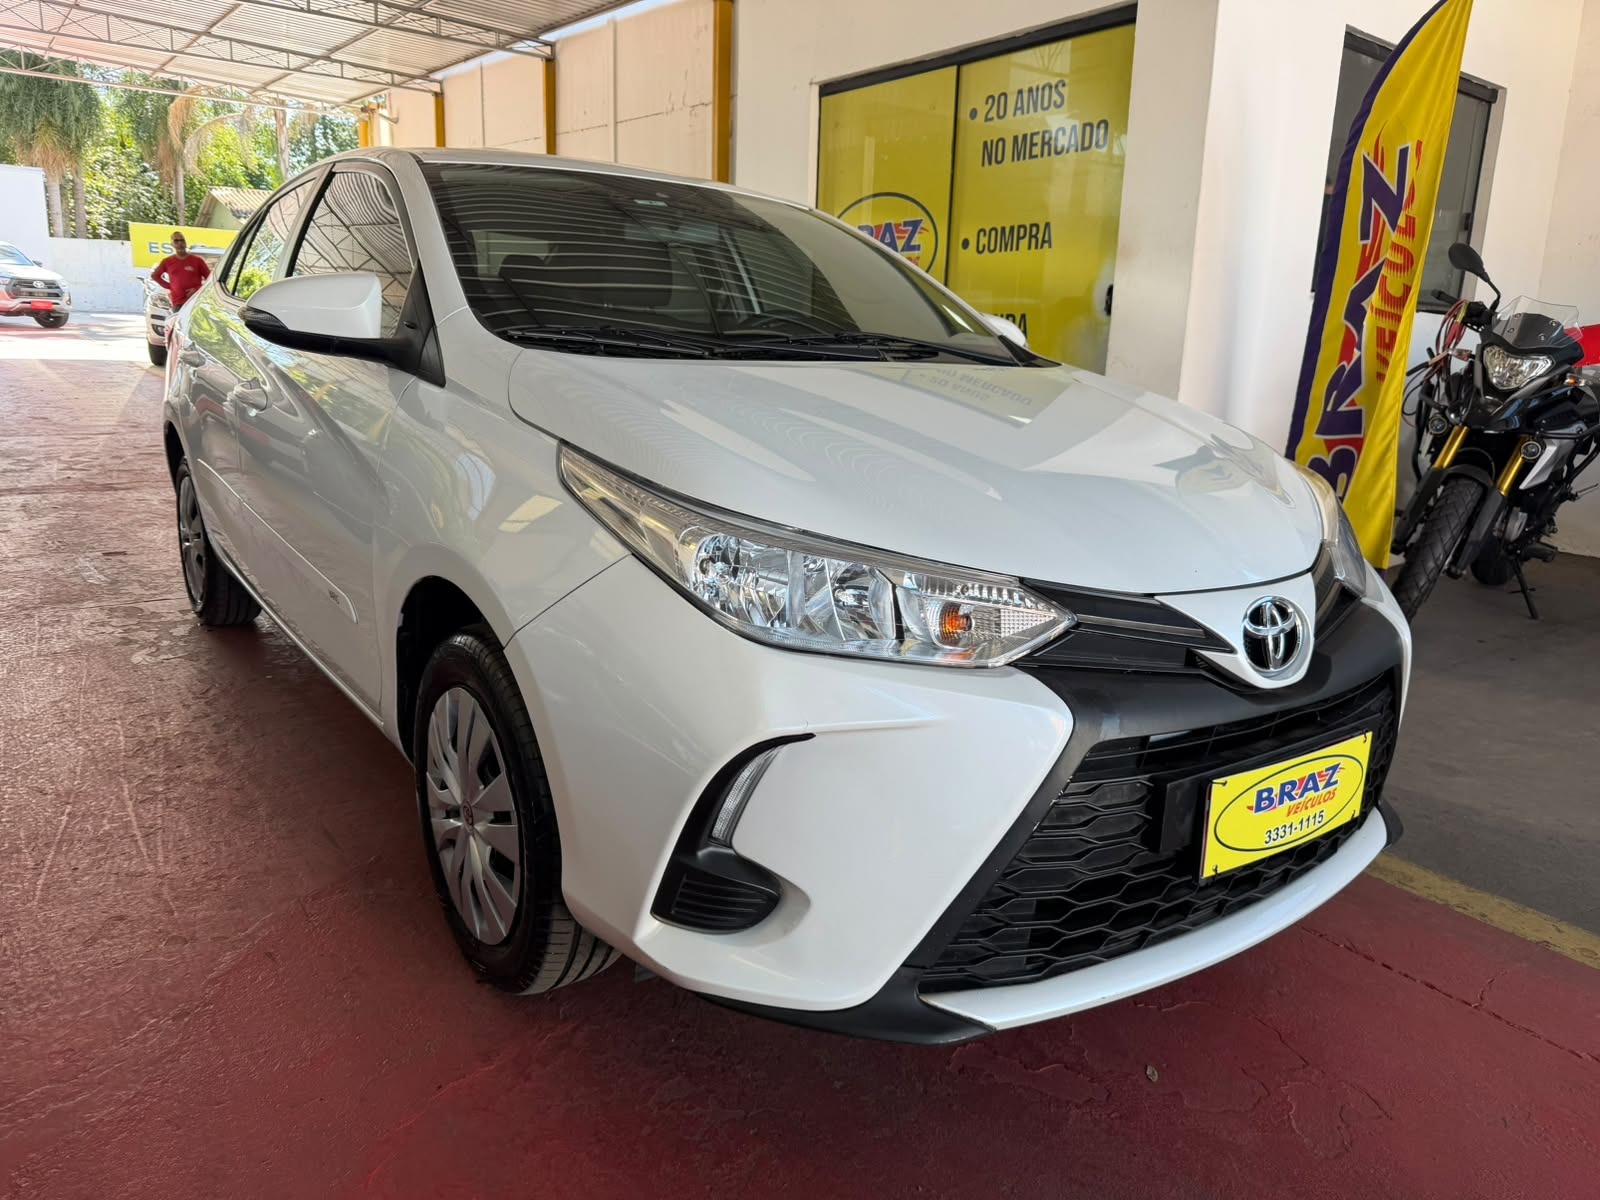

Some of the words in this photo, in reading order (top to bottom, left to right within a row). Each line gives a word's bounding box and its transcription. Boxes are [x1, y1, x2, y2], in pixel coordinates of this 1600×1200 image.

[984, 92, 1008, 122] 20
[1013, 80, 1066, 117] ANOS
[982, 137, 1006, 167] NO
[1011, 119, 1109, 162] MERCADO
[148, 241, 174, 255] ES
[976, 221, 1052, 254] COMPRA
[1253, 763, 1341, 814] BRAZ
[1264, 810, 1324, 844] 3331-1115
